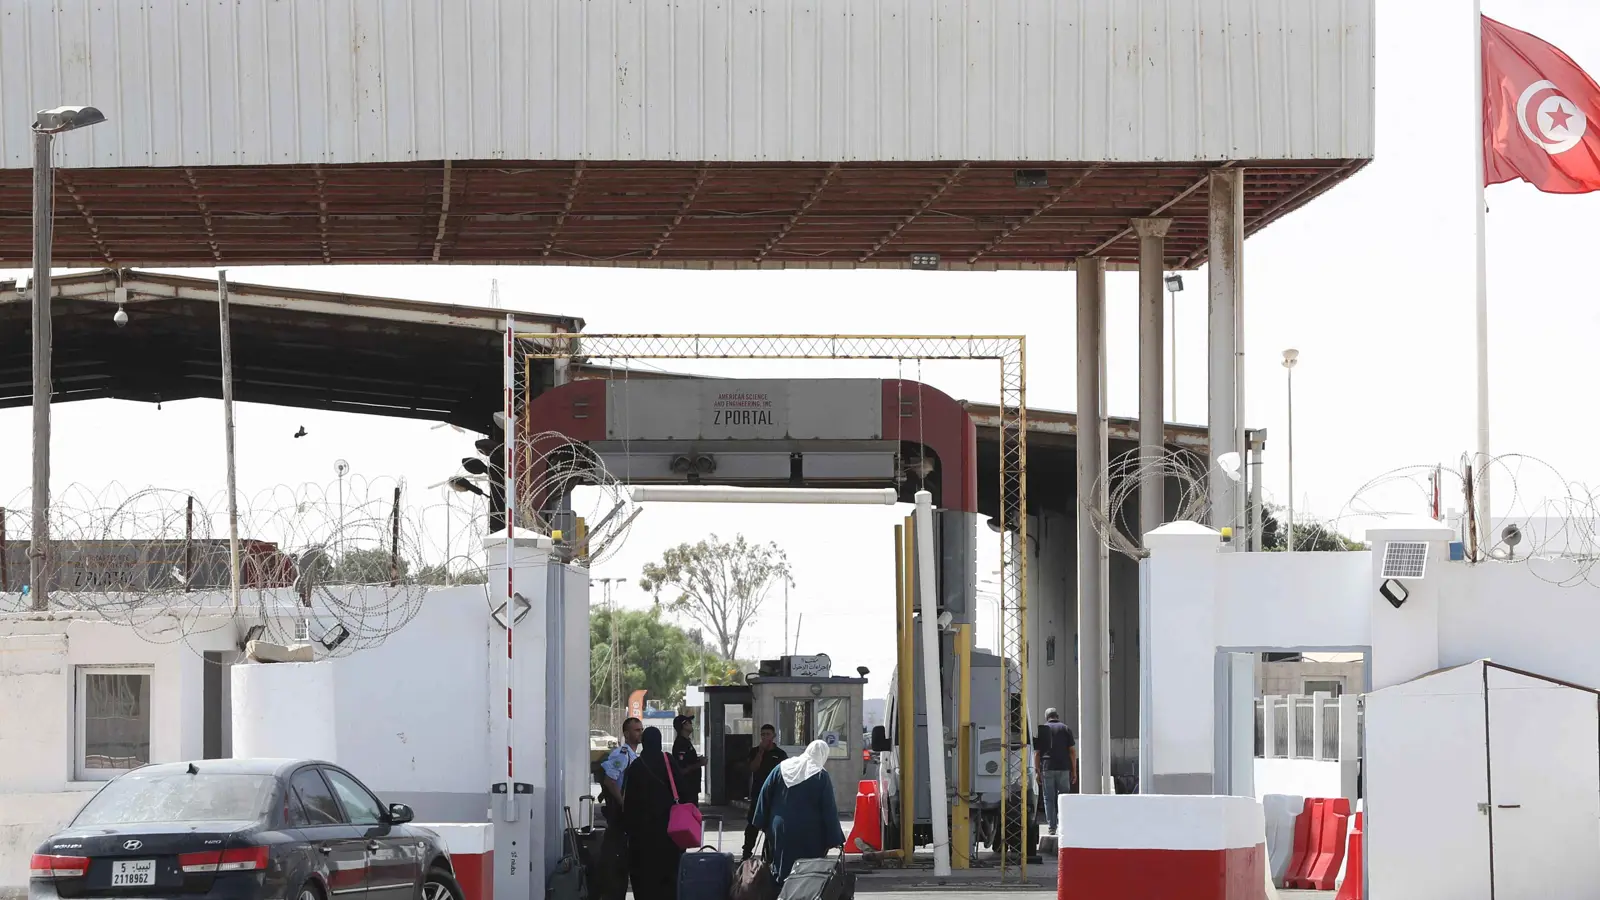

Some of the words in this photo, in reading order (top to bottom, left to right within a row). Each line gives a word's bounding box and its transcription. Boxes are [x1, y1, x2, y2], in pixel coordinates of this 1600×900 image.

[714, 410, 721, 425] Z
[725, 410, 774, 425] PORTAL
[121, 863, 126, 873] 5
[114, 873, 148, 884] 2118962
